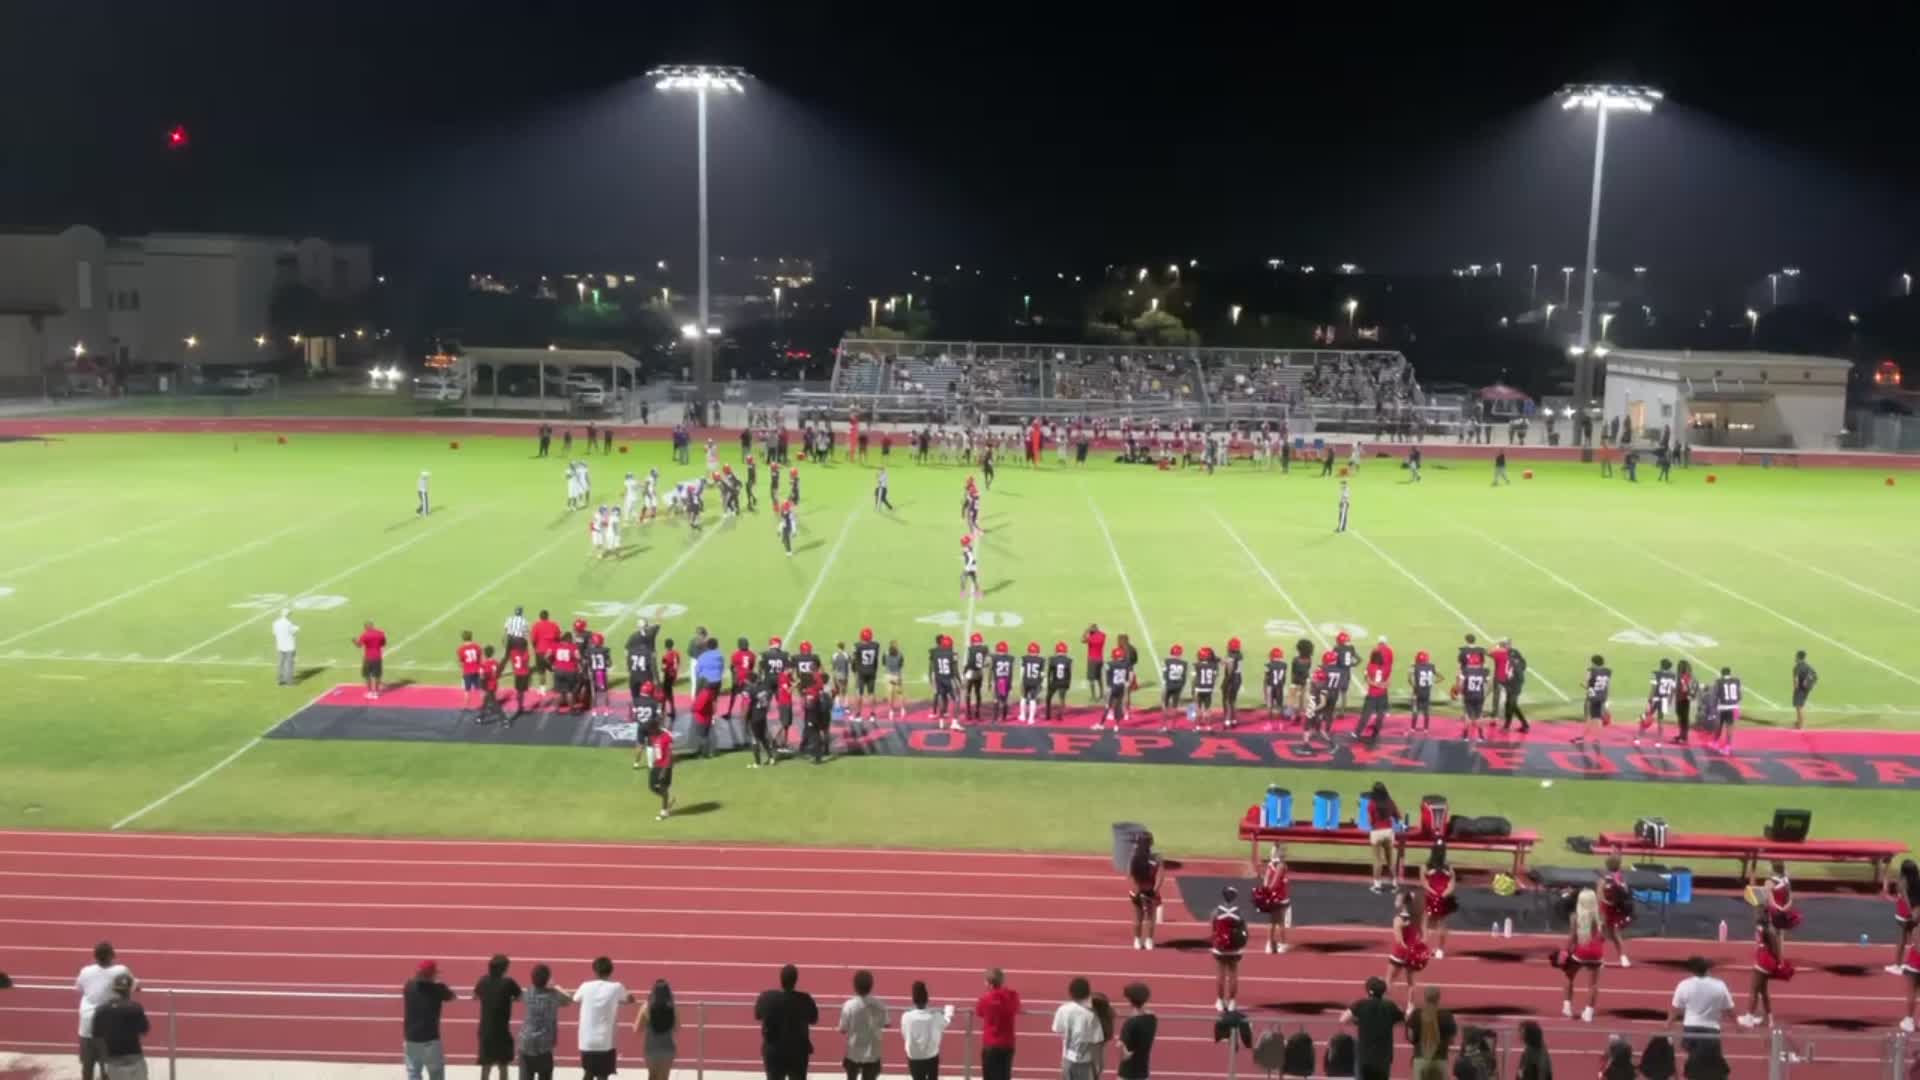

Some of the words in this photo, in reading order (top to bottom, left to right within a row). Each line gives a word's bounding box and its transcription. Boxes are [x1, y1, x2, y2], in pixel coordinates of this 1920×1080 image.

[913, 610, 1024, 627] 40
[591, 654, 606, 670] 13
[631, 655, 646, 671] 74
[861, 650, 876, 665] 57
[937, 658, 950, 675] 16
[1026, 663, 1041, 679] 15
[1328, 672, 1341, 688] 77
[1723, 683, 1738, 700] 10
